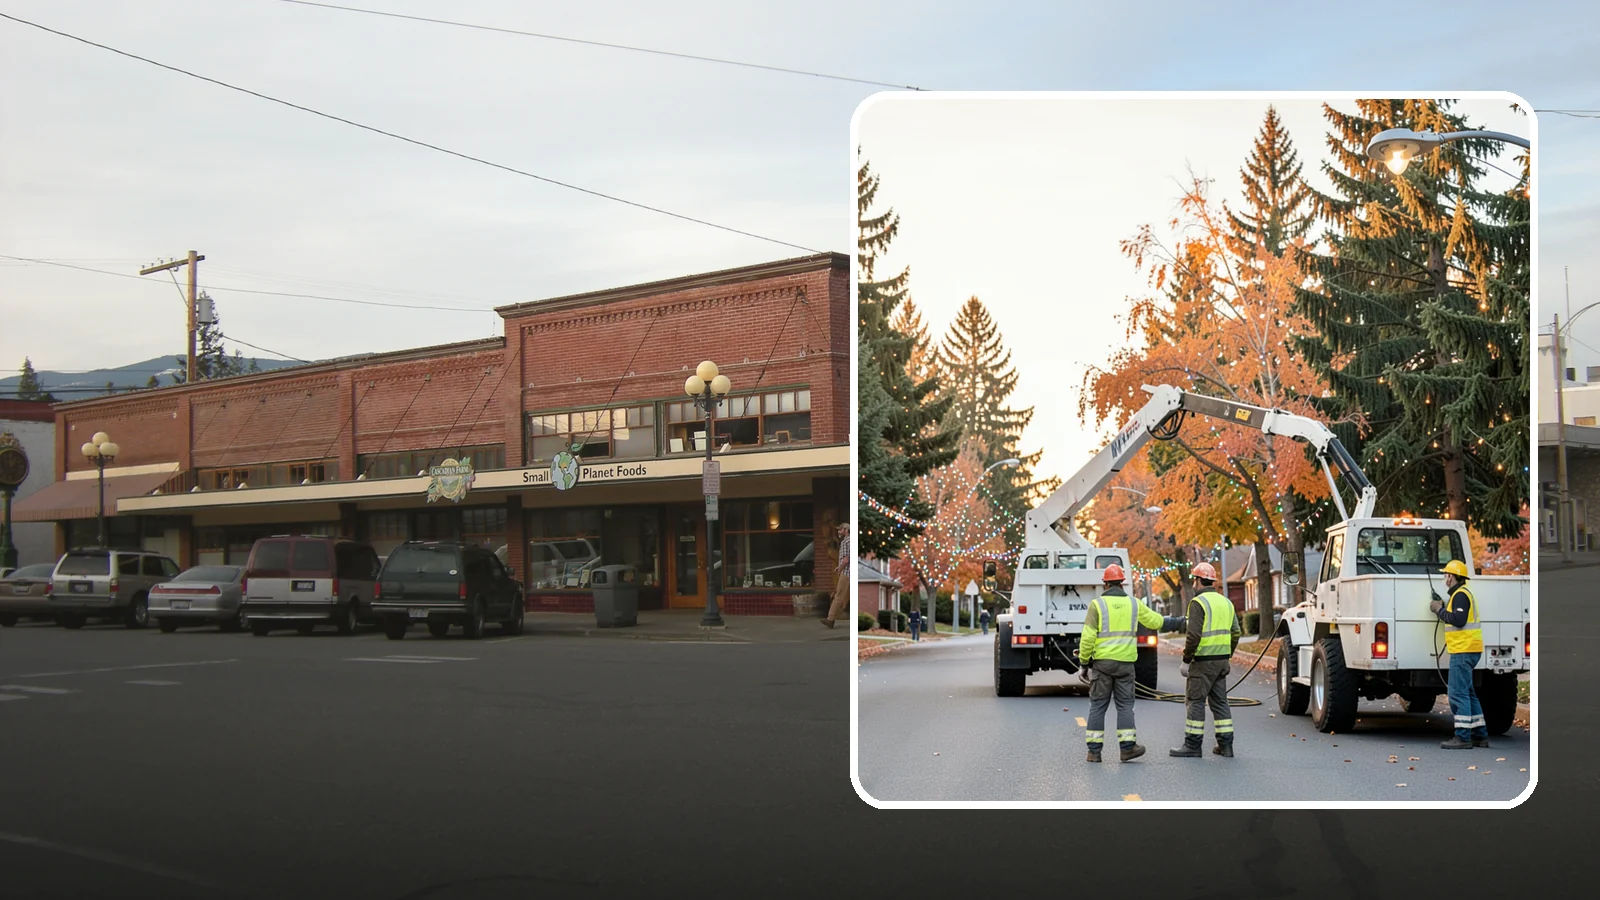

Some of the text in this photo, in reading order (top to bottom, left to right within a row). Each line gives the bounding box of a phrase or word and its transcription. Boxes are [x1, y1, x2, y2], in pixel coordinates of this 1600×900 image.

[523, 464, 647, 483] Small Planet Foods
